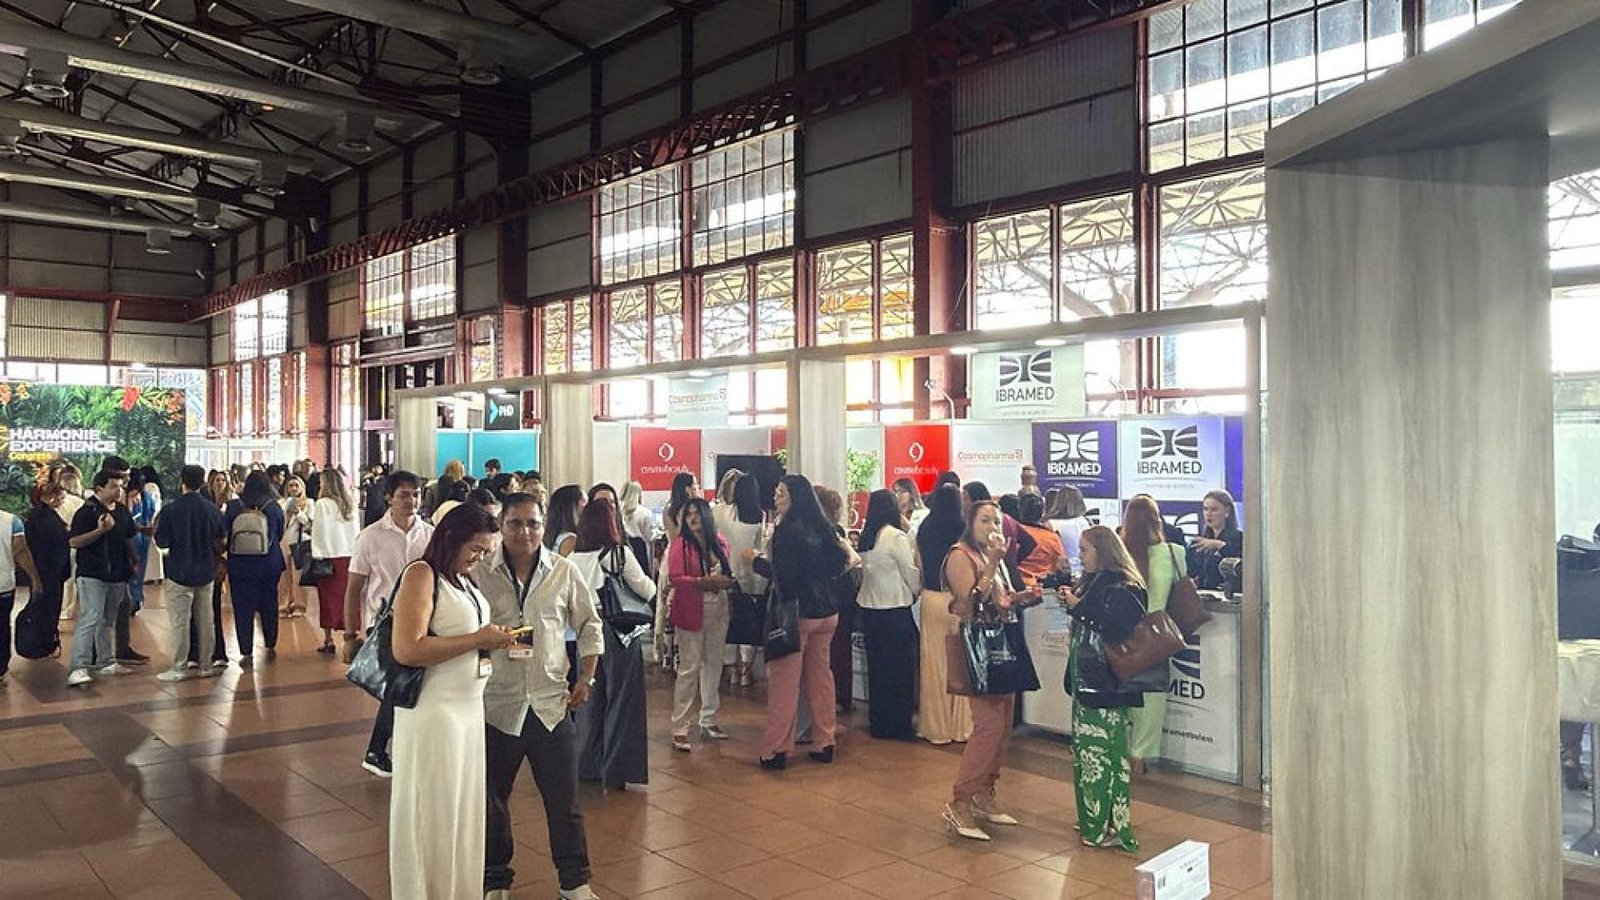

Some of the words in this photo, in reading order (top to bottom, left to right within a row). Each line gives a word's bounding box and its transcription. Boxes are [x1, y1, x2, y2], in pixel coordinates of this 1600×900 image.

[996, 386, 1055, 402] IBRAMED
[9, 428, 100, 440] HARMONIE
[9, 440, 117, 452] EXPERIENCE
[1047, 462, 1101, 475] IBRAMED
[1137, 461, 1203, 474] IBRAMED
